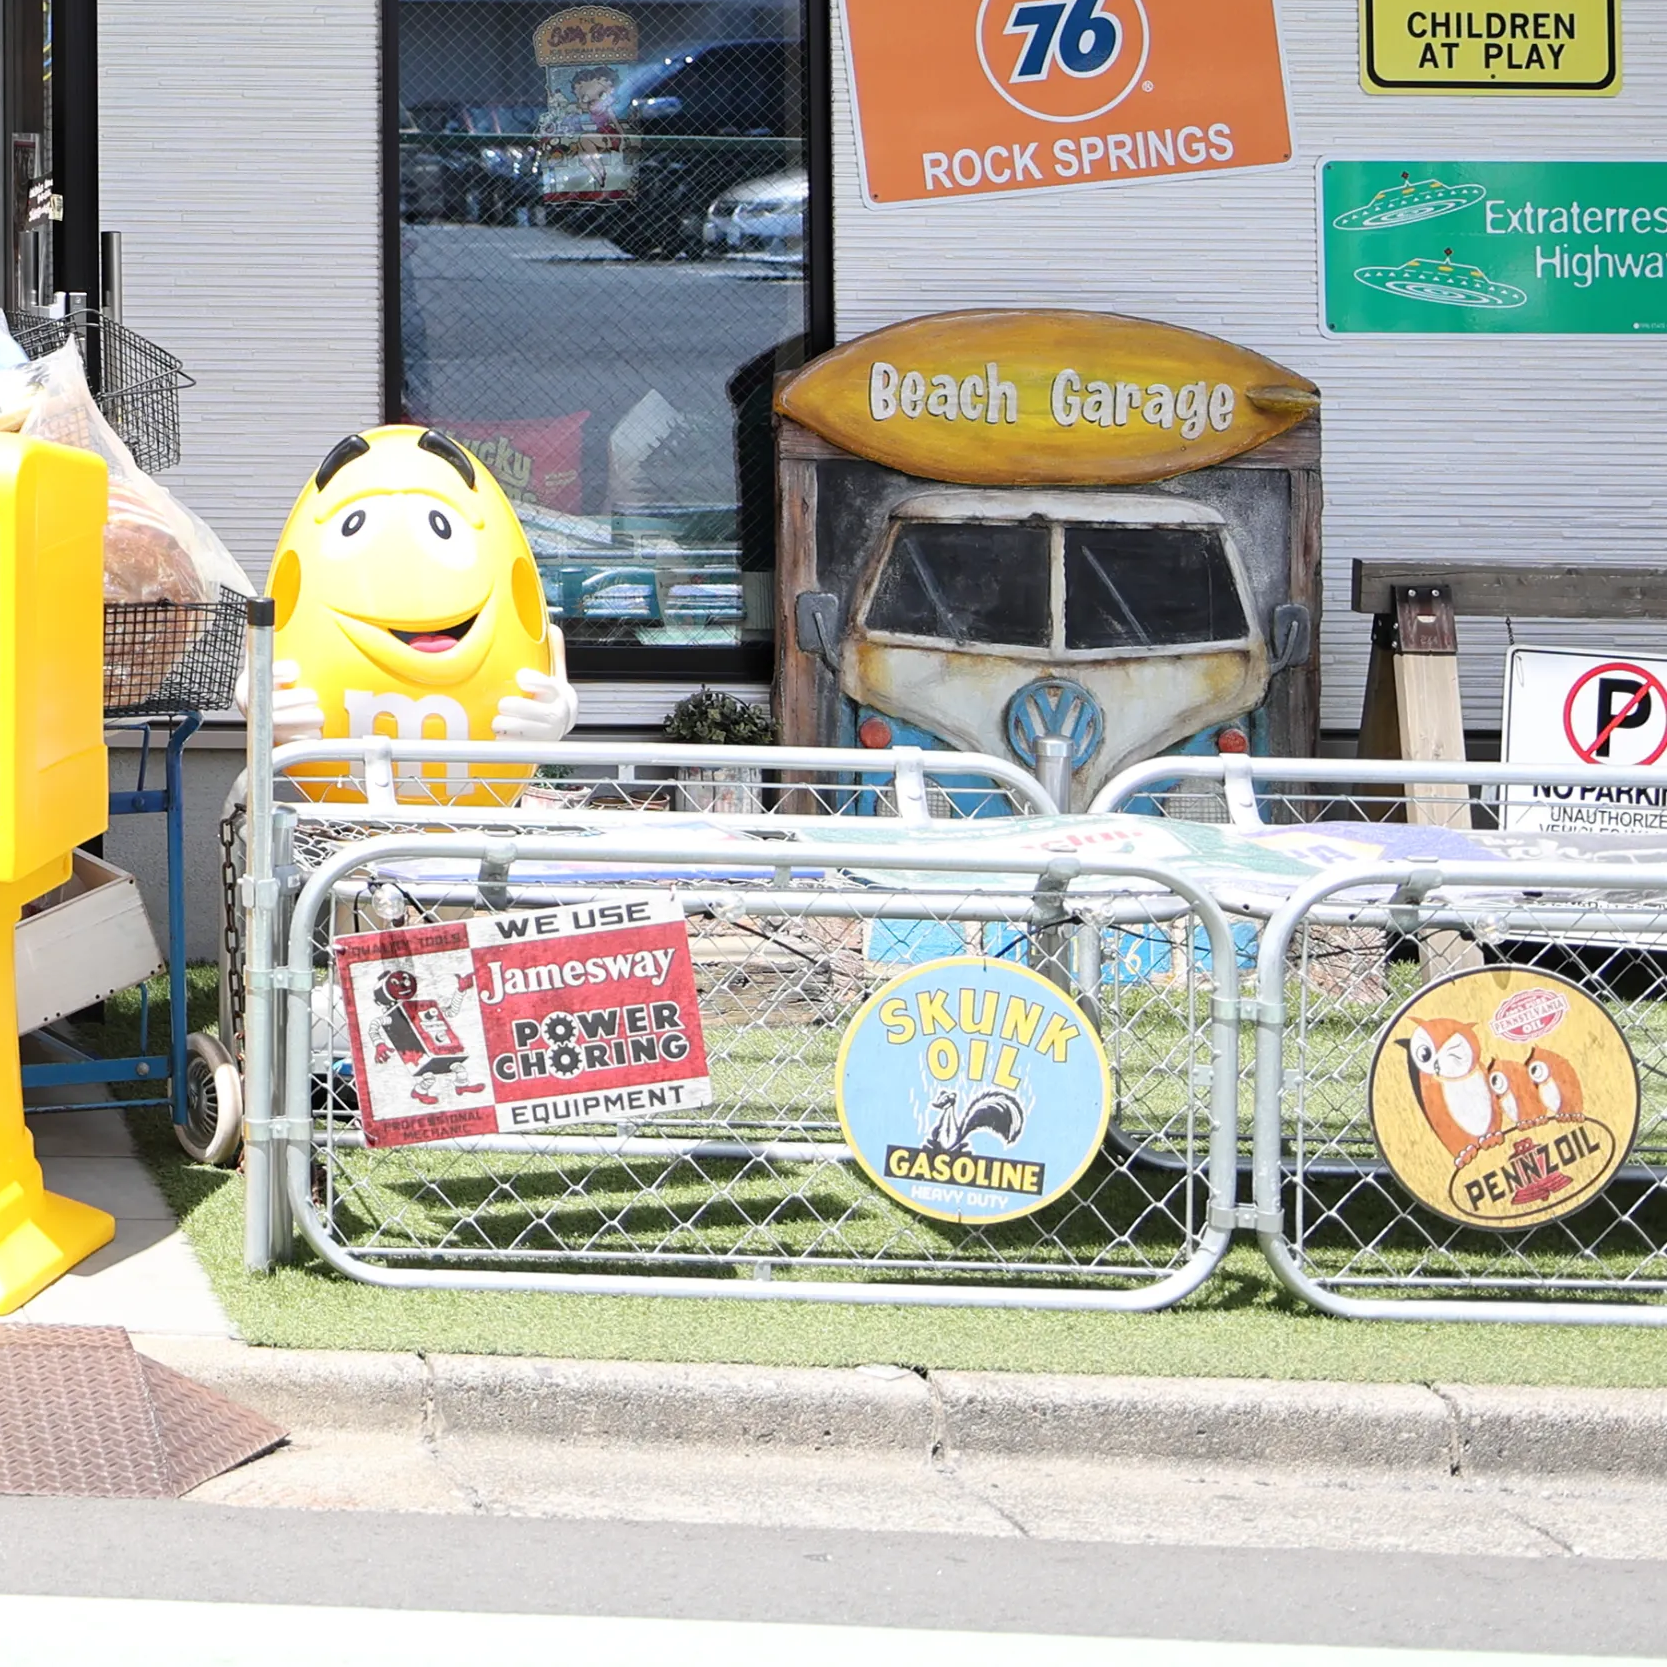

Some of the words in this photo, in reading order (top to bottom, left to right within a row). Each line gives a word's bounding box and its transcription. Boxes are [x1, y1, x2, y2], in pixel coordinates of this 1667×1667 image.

[1406, 11, 1576, 40] CHILDREN
[1418, 42, 1459, 70] AT
[1483, 42, 1566, 70] PLAY
[922, 141, 1043, 191] ROCK
[1053, 122, 1235, 177] SPRINGS
[868, 362, 1018, 424] Beach
[1050, 367, 1235, 440] Garage
[495, 913, 560, 940] WE
[573, 900, 651, 930] USE
[479, 948, 676, 1006] Jamesway
[513, 1000, 685, 1053] POWER
[878, 987, 1081, 1063] SKUNK
[1493, 998, 1564, 1031] PENNSYLVANIA
[1522, 1019, 1544, 1034] OIL
[492, 1033, 690, 1084] CHORING
[926, 1036, 1022, 1092] OIL
[382, 1110, 483, 1131] PROFESSIONAL
[511, 1084, 685, 1126] EQUIPMENT
[403, 1125, 472, 1141] MECHANIC
[887, 1148, 1042, 1193] GASOLINE
[1464, 1125, 1601, 1212] PENNZOIL
[910, 1185, 965, 1205] HEAVY
[967, 1191, 1010, 1209] DUTY
